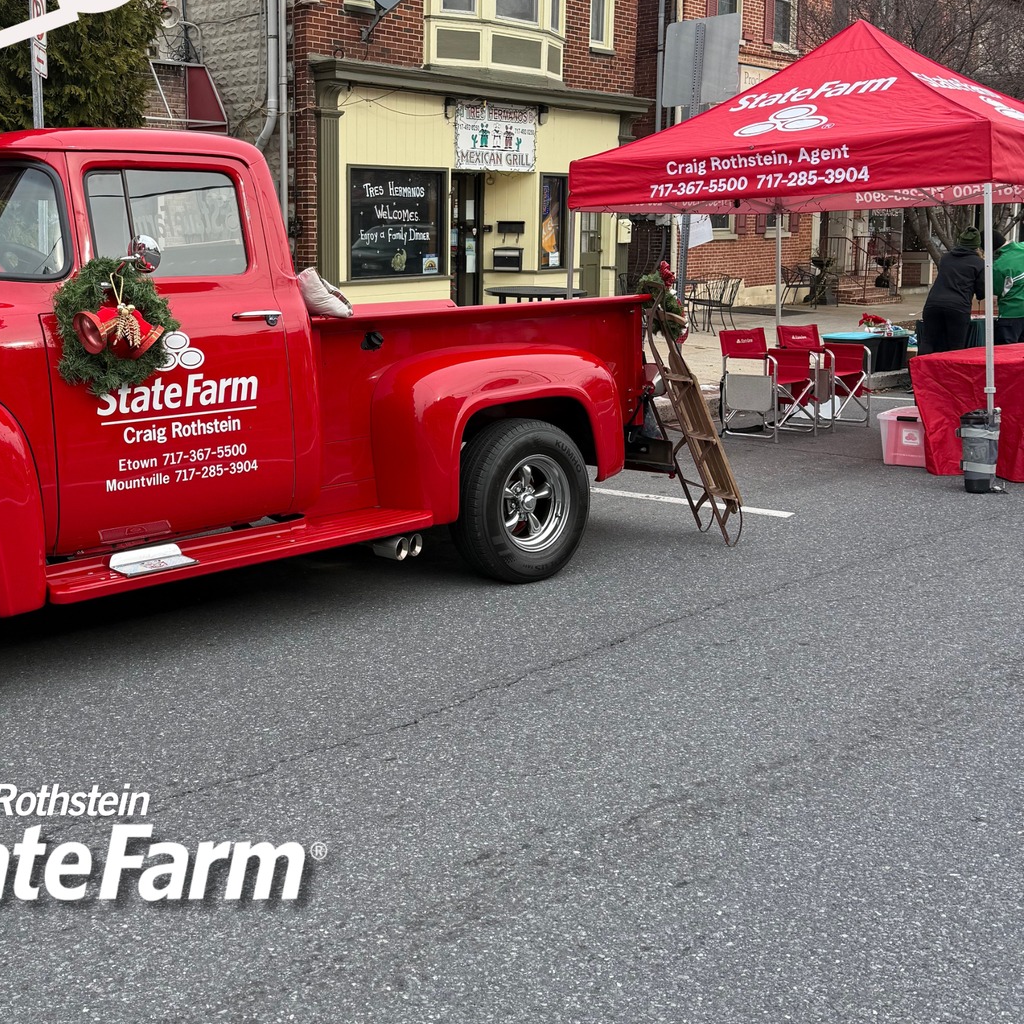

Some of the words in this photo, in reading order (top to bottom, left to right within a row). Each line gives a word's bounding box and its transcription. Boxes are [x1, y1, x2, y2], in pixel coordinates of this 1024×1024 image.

[460, 150, 503, 165] MEXICAN
[505, 152, 532, 167] GRILL
[666, 158, 707, 177] Craig
[711, 149, 793, 172] Rothstein,
[797, 144, 850, 166] Agent
[649, 176, 748, 199] 717-367-5500
[756, 165, 870, 190] 717-285-3904
[123, 424, 168, 444] Craig
[171, 416, 241, 439] Rothstein
[118, 457, 158, 472] Etown
[162, 443, 247, 466] 717-367-5500
[105, 472, 170, 493] Mountville
[175, 459, 258, 483] 717-285-3904
